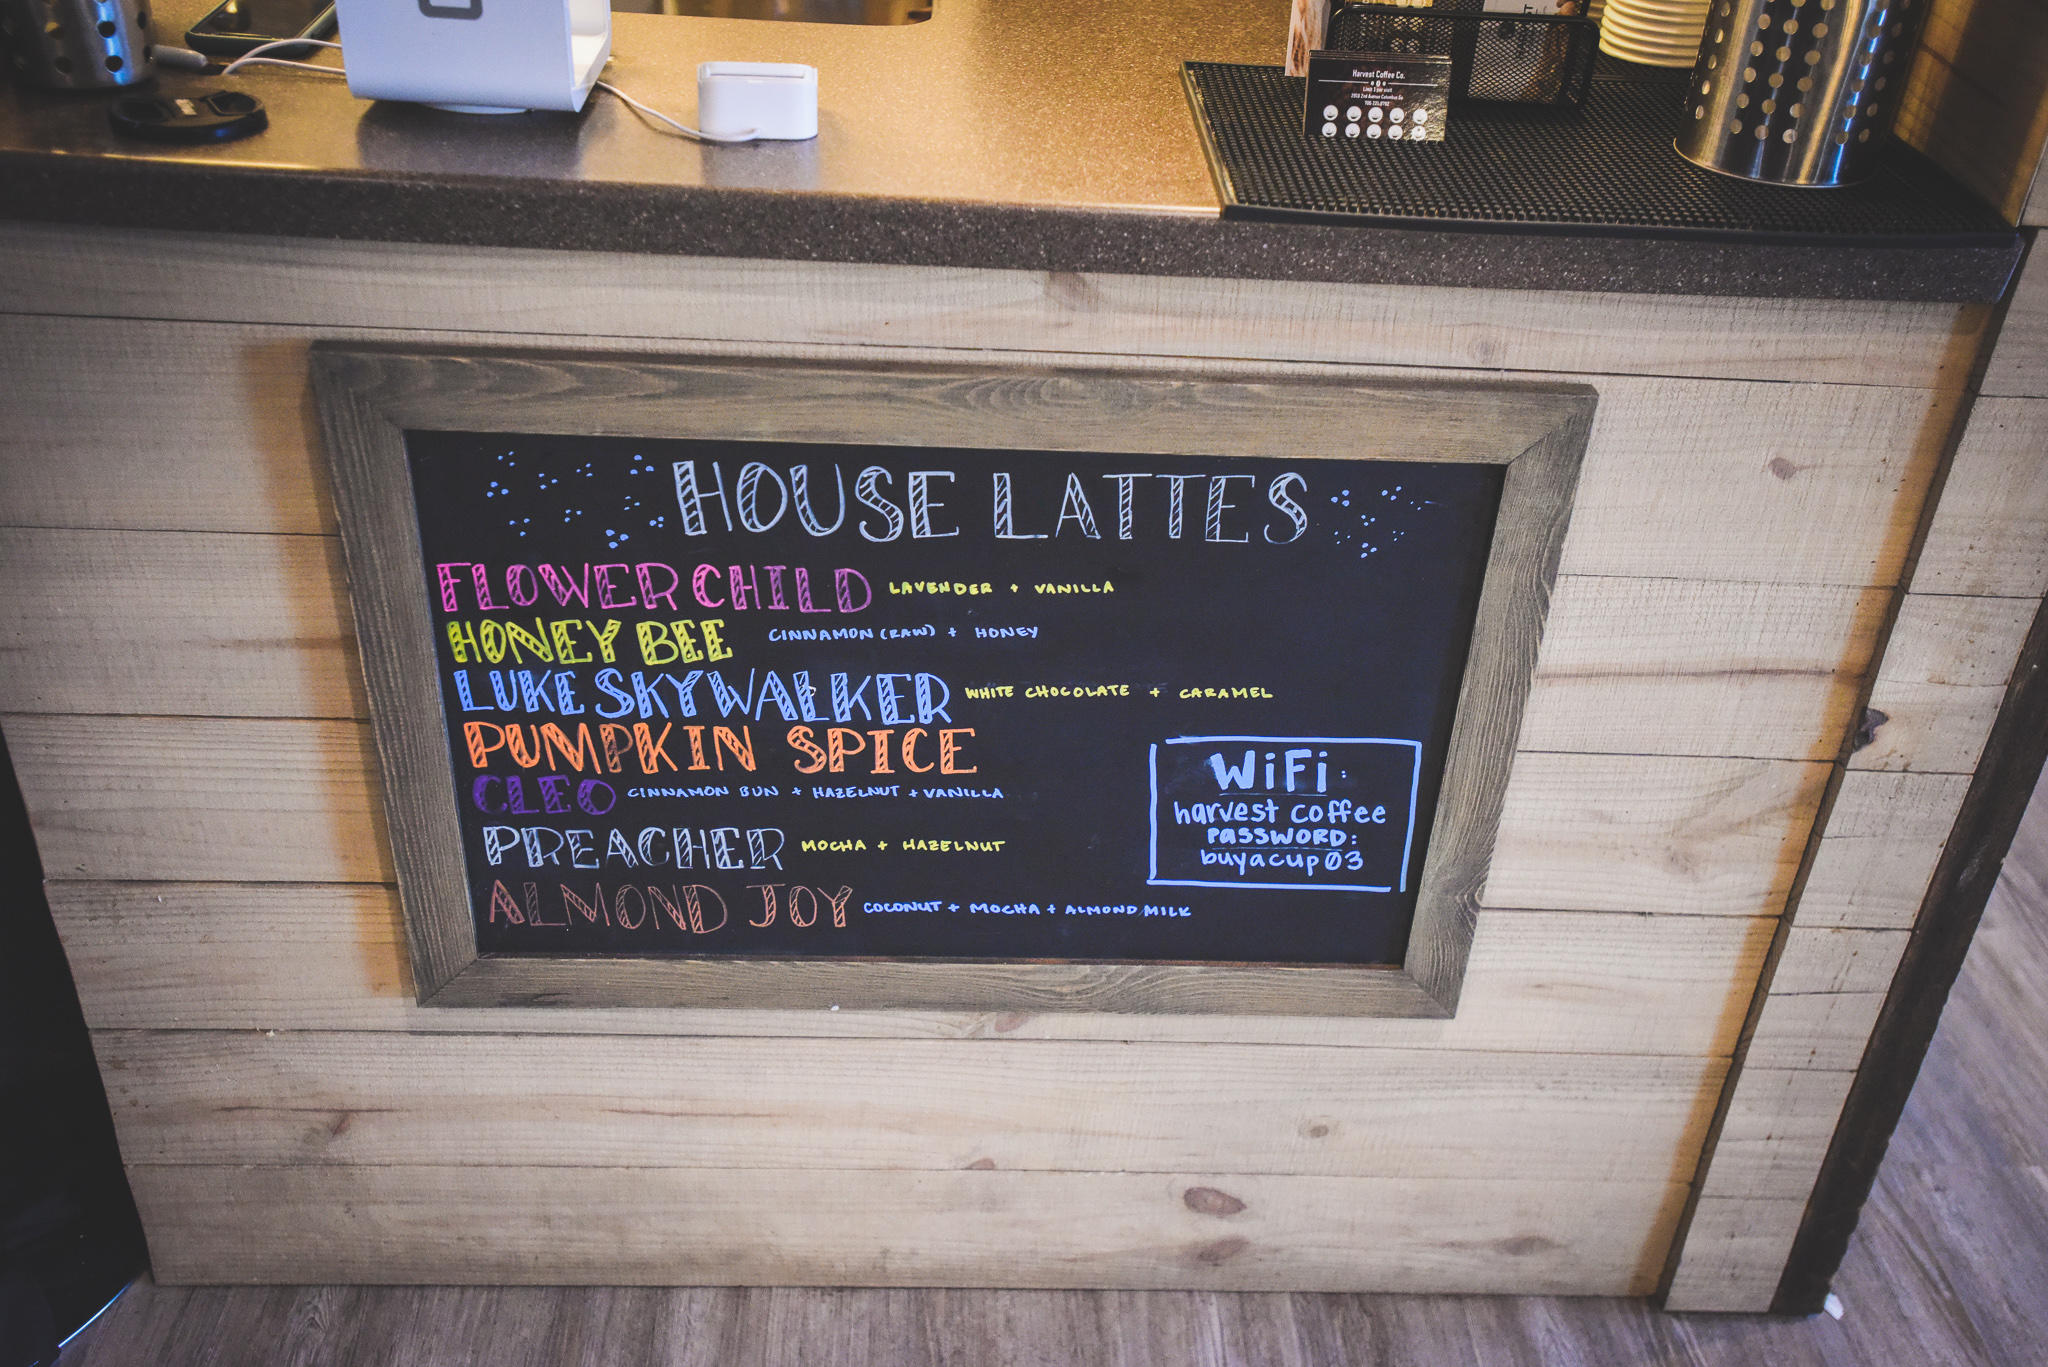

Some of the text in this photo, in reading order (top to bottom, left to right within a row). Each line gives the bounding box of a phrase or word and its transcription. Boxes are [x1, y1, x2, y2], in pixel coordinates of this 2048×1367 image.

[1352, 69, 1406, 79] Harvest Coffee Co.
[673, 460, 1308, 545] HOUSE LATTES
[436, 562, 873, 614] FLOWER CHILD
[888, 580, 993, 596] LAVENDER
[1034, 580, 1115, 595] VANILLA
[446, 617, 734, 666] HONEY BEE
[768, 627, 875, 642] CINNAMON
[879, 623, 936, 641] (RAW)
[974, 625, 1039, 639] HONEY
[453, 667, 953, 725] LUKE SKYWALKER
[964, 685, 1015, 700] WHITE
[1024, 684, 1131, 699] CHOCOLATE
[1178, 686, 1274, 701] CARAMEL
[463, 721, 979, 776] PUMPKIN SPICE
[472, 774, 617, 816] CLEO
[626, 784, 730, 799] CINNAMON
[738, 785, 780, 798] BUN
[811, 784, 902, 800] HAZELNUT
[922, 786, 1005, 801] VANILLA
[1173, 798, 1387, 825] harvest coffee
[482, 825, 785, 871] PREACHER
[801, 839, 867, 853] MOCHA
[902, 838, 1006, 853] HAZELNUT
[489, 879, 728, 935] ALMOND
[745, 883, 854, 929] JOY
[862, 899, 943, 914] COCONUT
[968, 901, 1041, 916] MOCHA
[1064, 903, 1139, 917] ALMOND
[1143, 903, 1193, 919] MILK
